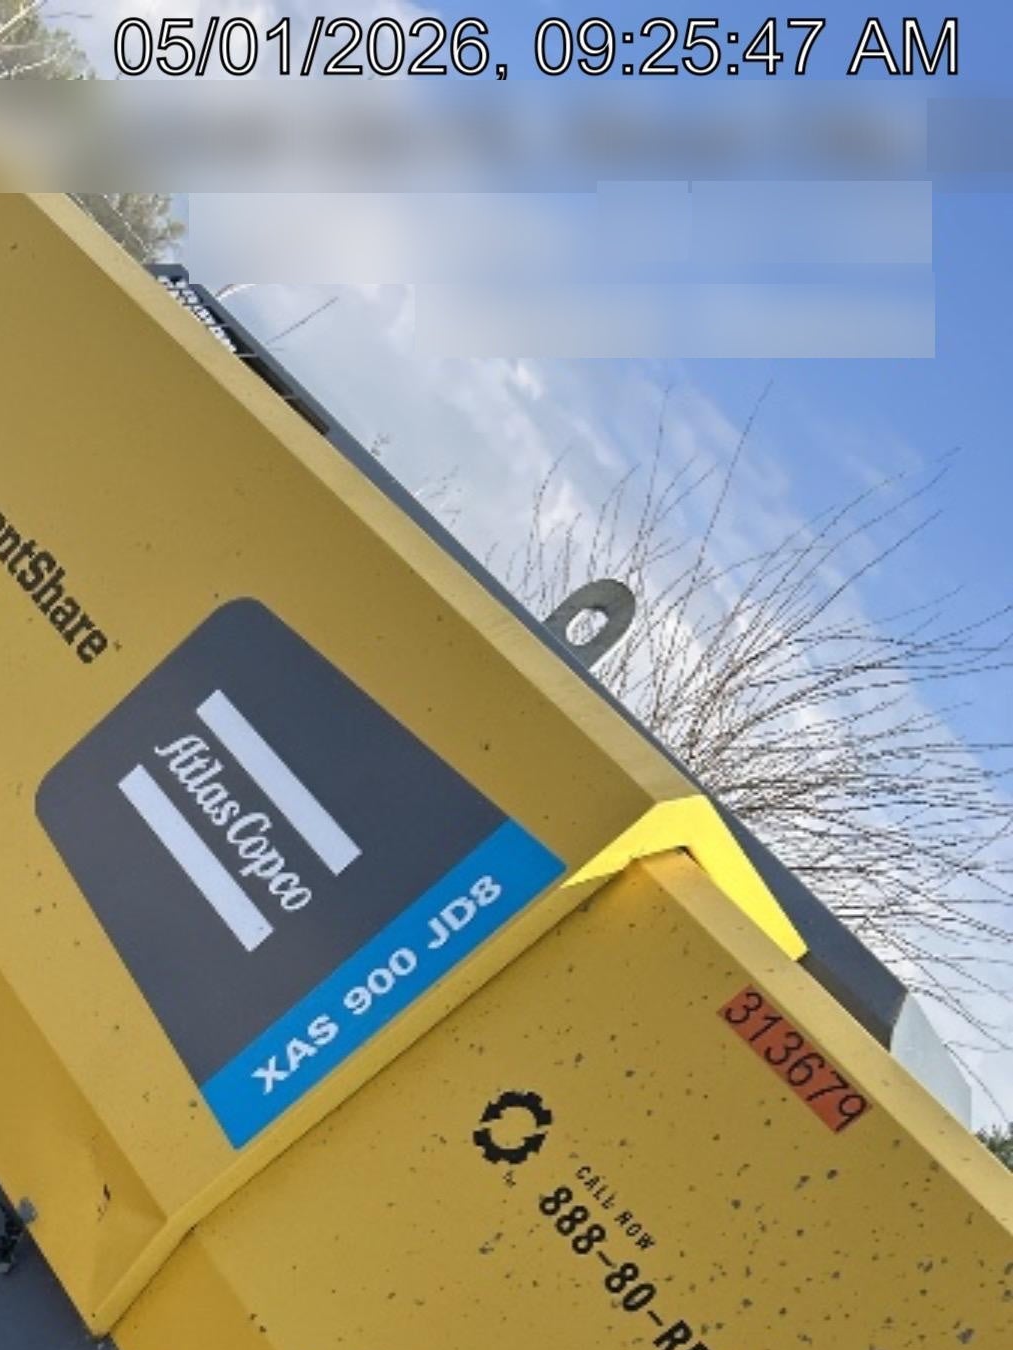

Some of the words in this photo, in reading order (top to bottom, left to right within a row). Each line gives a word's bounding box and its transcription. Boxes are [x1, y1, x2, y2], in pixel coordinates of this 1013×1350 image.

[250, 1015, 342, 1097] XAS
[343, 946, 419, 1016] 900
[427, 874, 504, 950] JD8
[724, 991, 869, 1125] 313679
[574, 1164, 617, 1211] CALL
